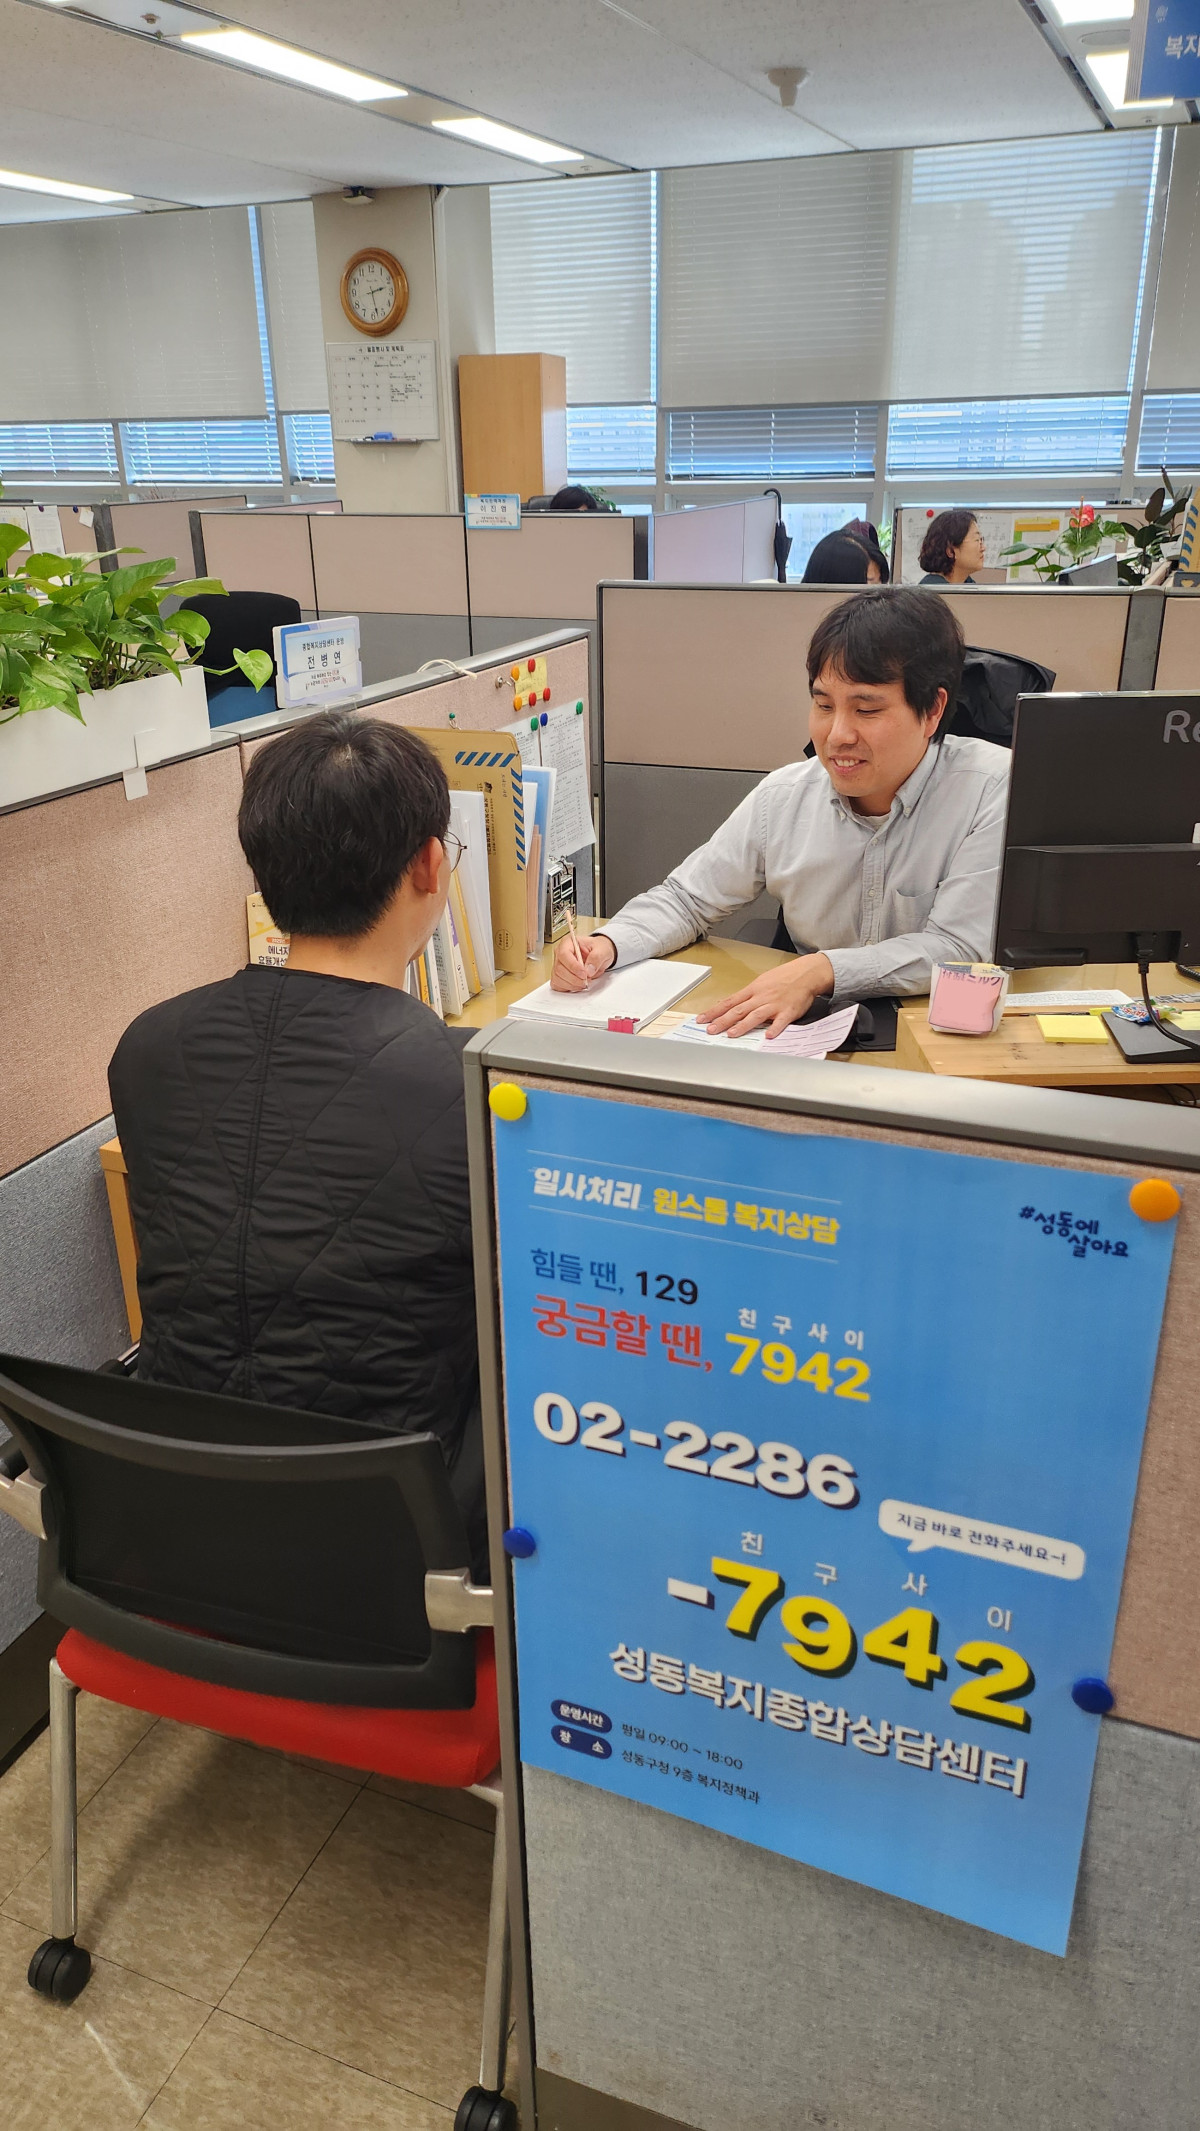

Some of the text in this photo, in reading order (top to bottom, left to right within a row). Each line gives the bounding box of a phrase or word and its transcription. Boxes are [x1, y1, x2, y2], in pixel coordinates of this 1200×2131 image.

[533, 1167, 841, 1245] 일사처리 원스톱 복지상담
[1019, 1205, 1100, 1238] #성동에
[1067, 1234, 1130, 1259] 살아요
[530, 1247, 699, 1306] 힘들 땐, 129
[532, 1294, 871, 1403] 궁금할 땐, 7942
[737, 1307, 865, 1352] 친 구 사 이
[533, 1391, 860, 1511] 02-2286
[896, 1511, 927, 1532] 지금
[931, 1519, 963, 1540] 바로
[739, 1530, 1013, 1632] 친 구 사 이
[560, 1703, 604, 1728] 운영시간
[609, 1641, 1029, 1799] 성동복지종합상담센터
[621, 1723, 646, 1740] 평일
[649, 1732, 689, 1754] 09:00
[706, 1749, 743, 1770] 18:00
[621, 1749, 760, 1805] 성동구청 9층 복지정책과
